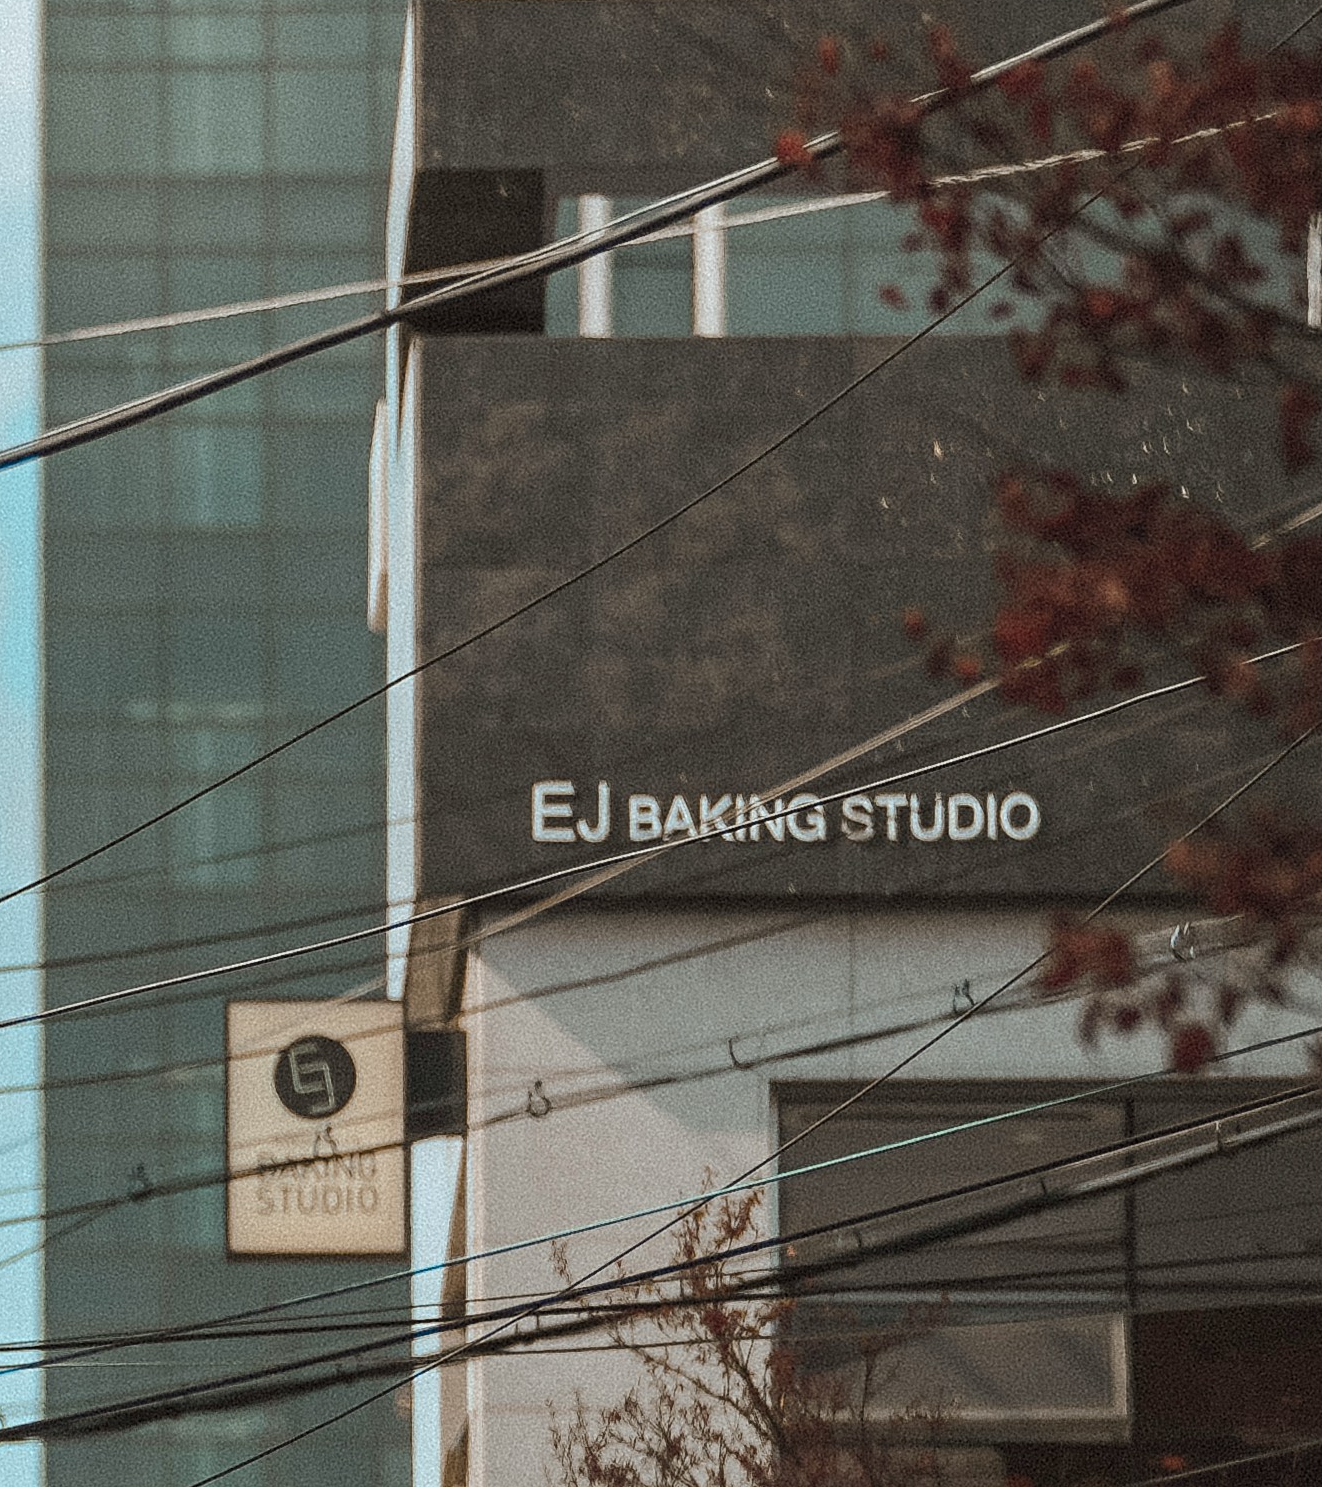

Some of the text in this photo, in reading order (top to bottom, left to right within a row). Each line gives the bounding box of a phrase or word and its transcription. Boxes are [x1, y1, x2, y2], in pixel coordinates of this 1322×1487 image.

[531, 779, 1041, 843] EJ BAKING STUDIO
[256, 1184, 378, 1215] STUDIO
